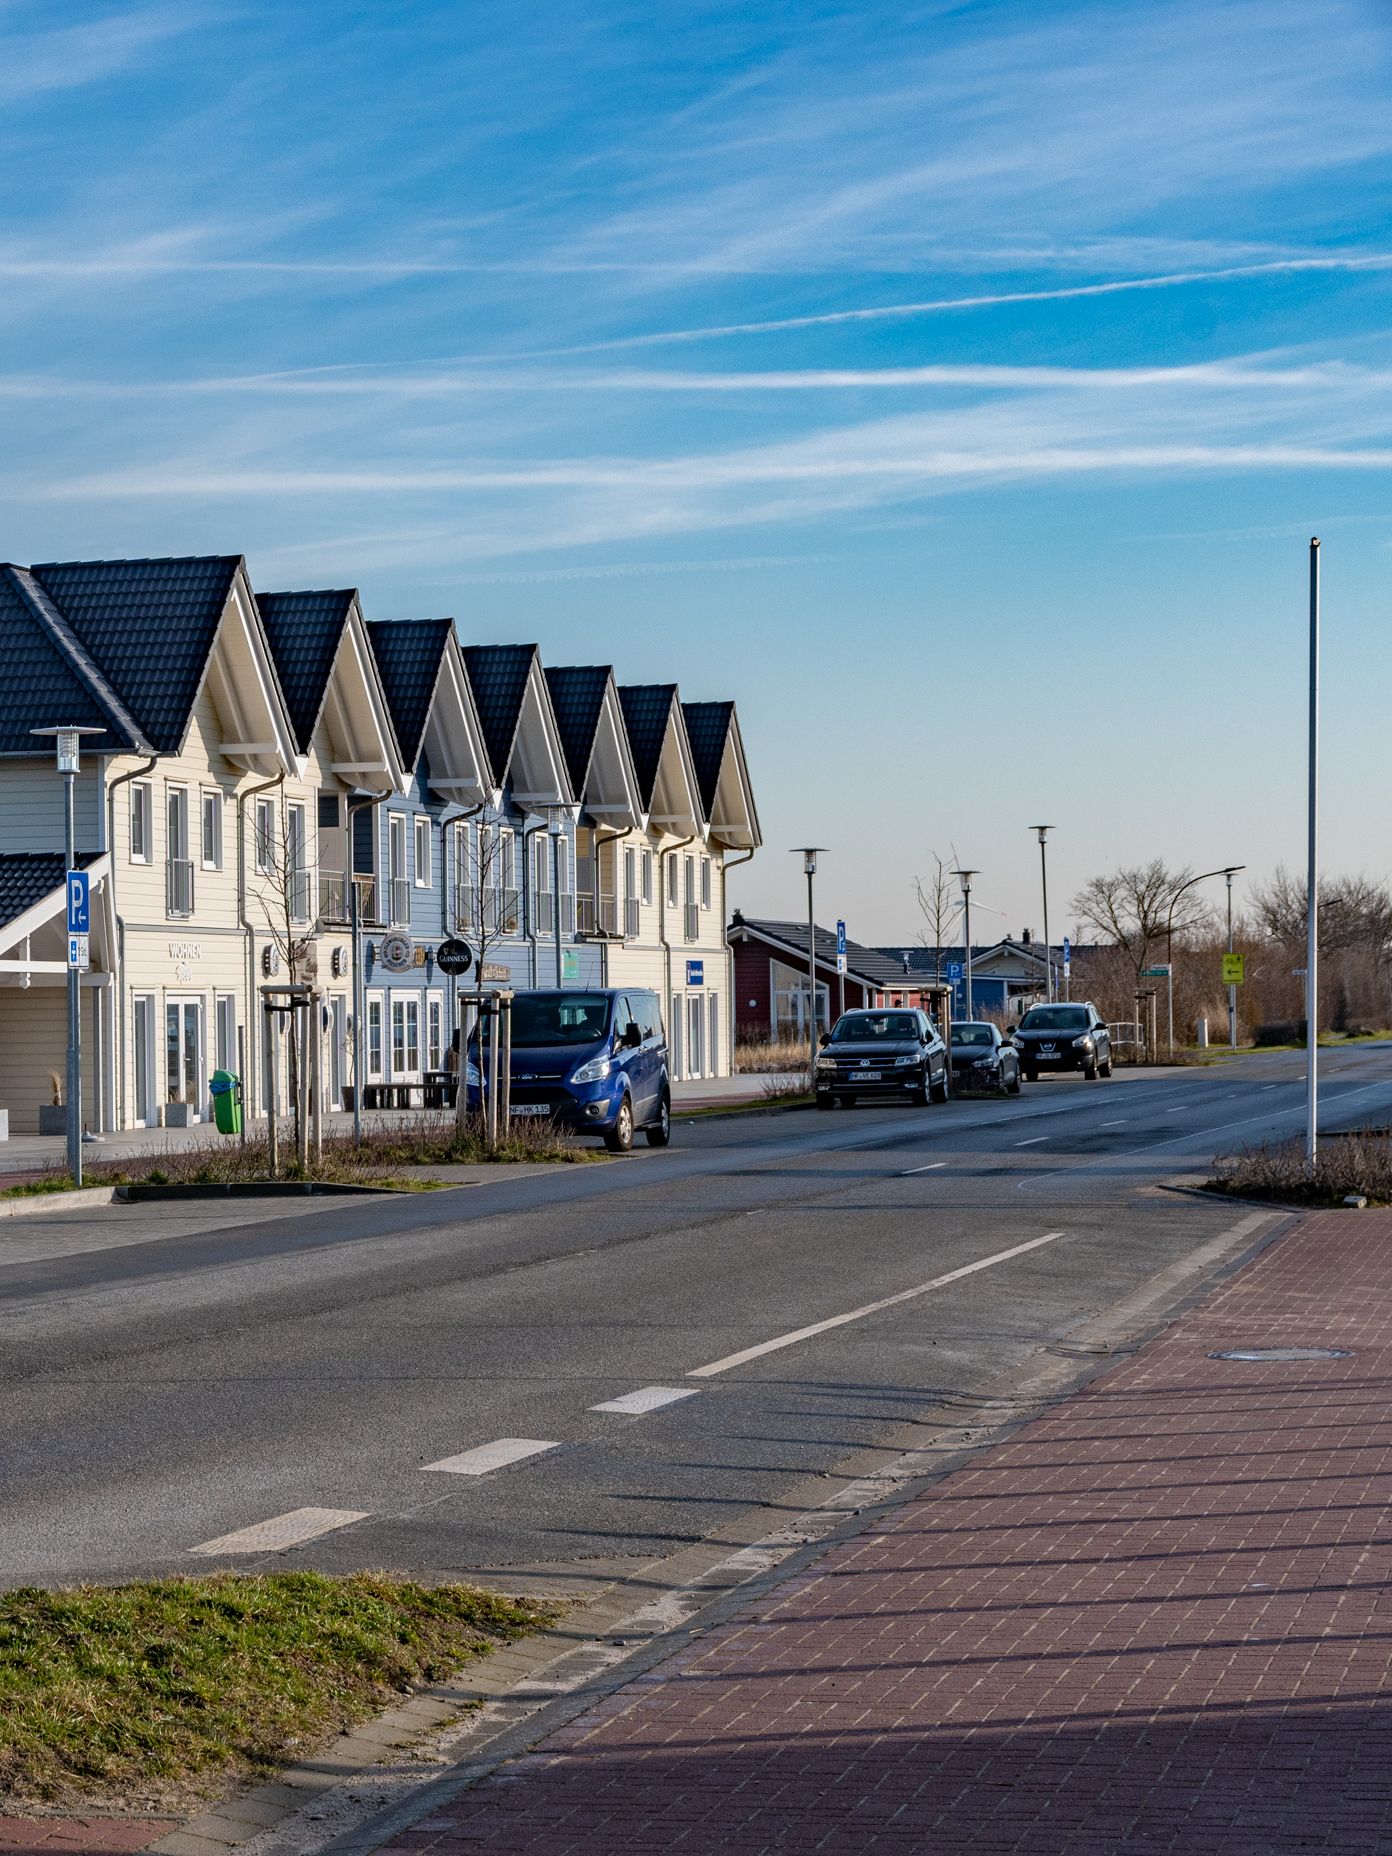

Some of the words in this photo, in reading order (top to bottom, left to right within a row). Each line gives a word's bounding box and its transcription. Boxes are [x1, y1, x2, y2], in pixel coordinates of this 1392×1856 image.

[71, 879, 84, 925] P
[439, 954, 469, 963] GUINNESS
[950, 965, 960, 977] P
[510, 1106, 520, 1114] NF
[523, 1106, 534, 1114] HK
[535, 1105, 549, 1113] 135
